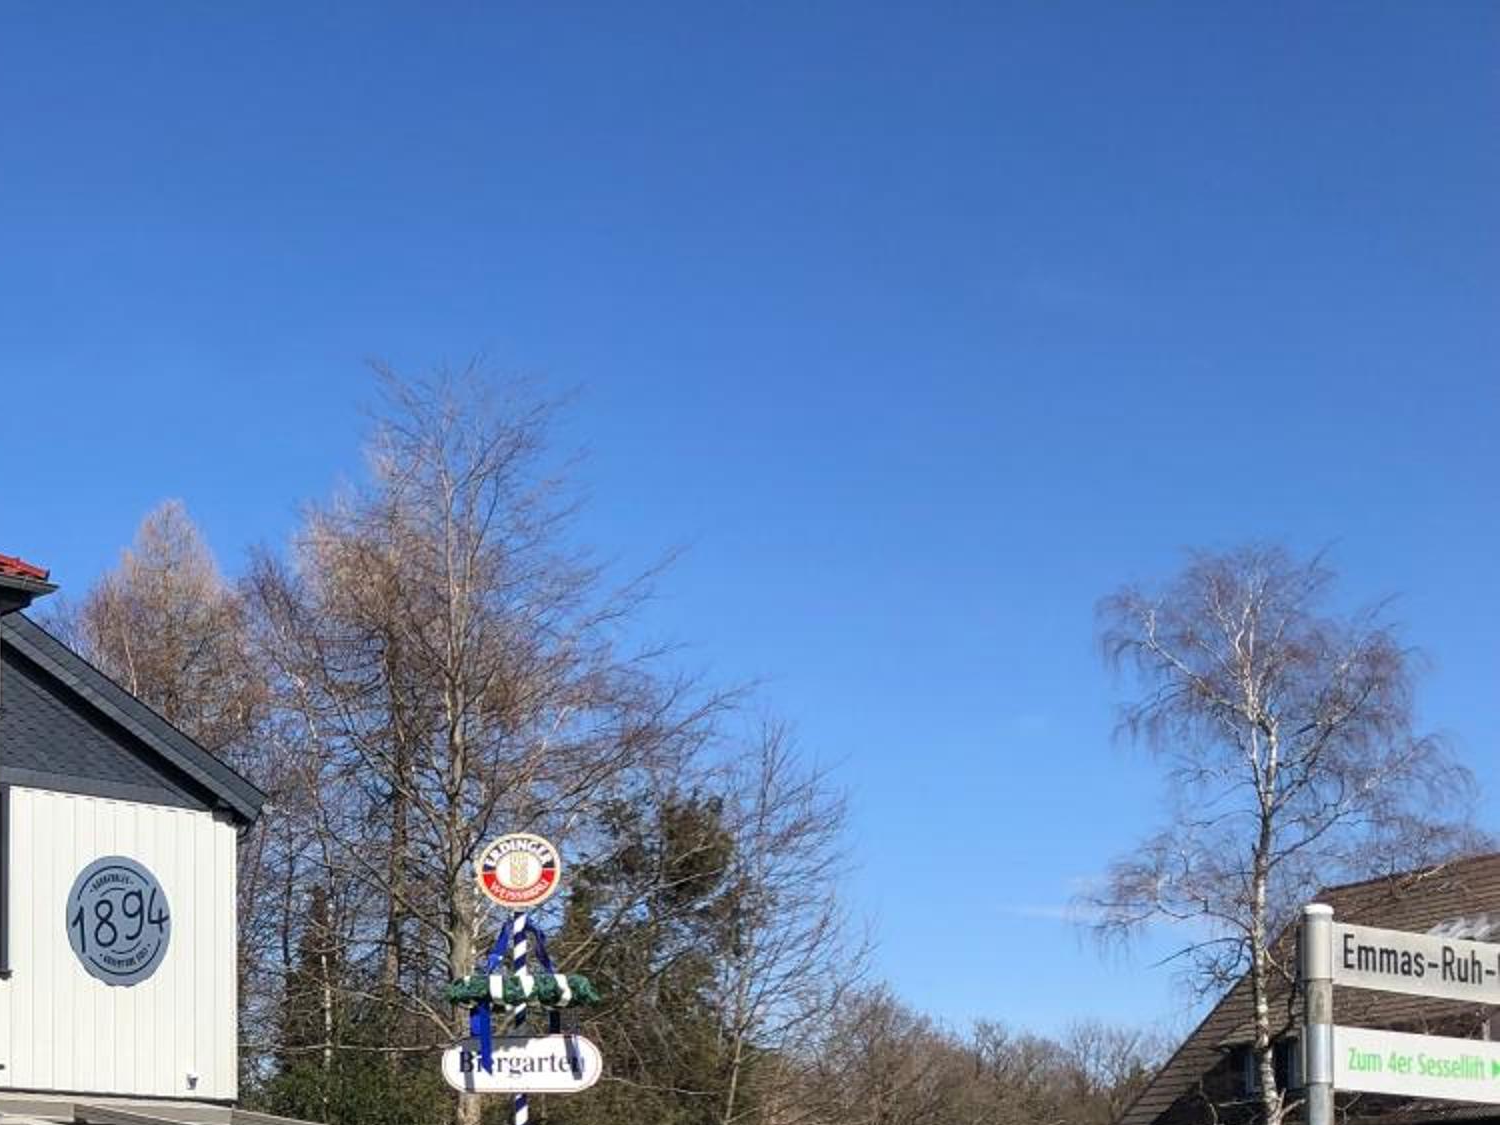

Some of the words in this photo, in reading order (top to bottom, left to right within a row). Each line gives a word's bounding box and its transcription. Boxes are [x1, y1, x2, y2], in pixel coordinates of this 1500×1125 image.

[483, 840, 553, 867] ERDINGER
[71, 887, 170, 954] 1894
[459, 1051, 586, 1075] Birgarten
[1349, 1048, 1382, 1072] Zum
[1387, 1051, 1413, 1074] 4er
[1418, 1053, 1485, 1080] Sessellift
